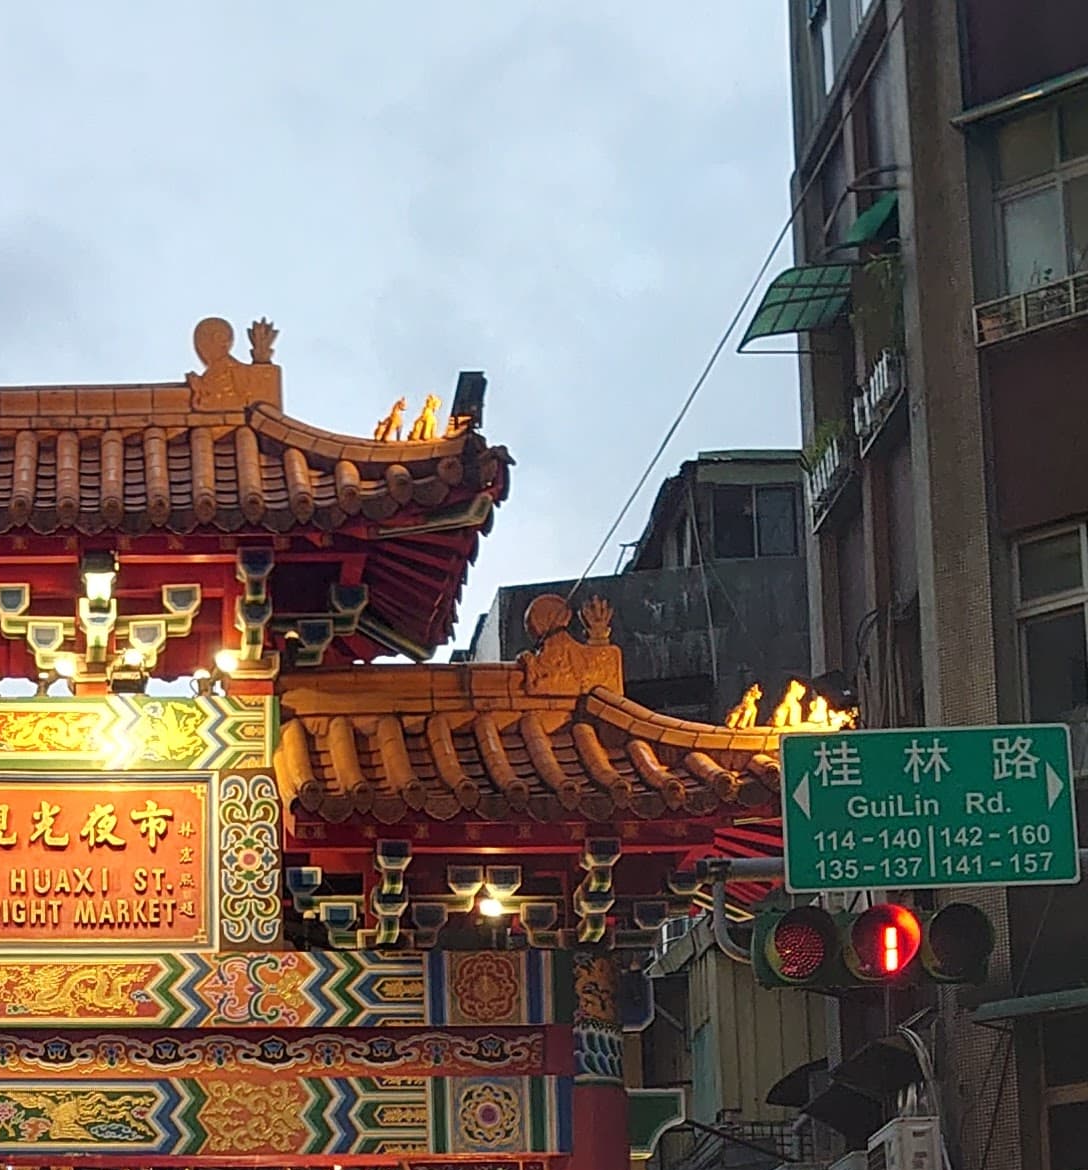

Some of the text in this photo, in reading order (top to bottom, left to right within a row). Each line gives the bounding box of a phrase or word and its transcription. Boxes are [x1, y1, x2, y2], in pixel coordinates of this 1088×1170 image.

[814, 736, 1040, 787] 桂林路
[847, 792, 1012, 818] GuiLin Rd.
[9, 867, 110, 896] HUAXI
[133, 867, 173, 895] ST.
[73, 899, 177, 926] MARKET
